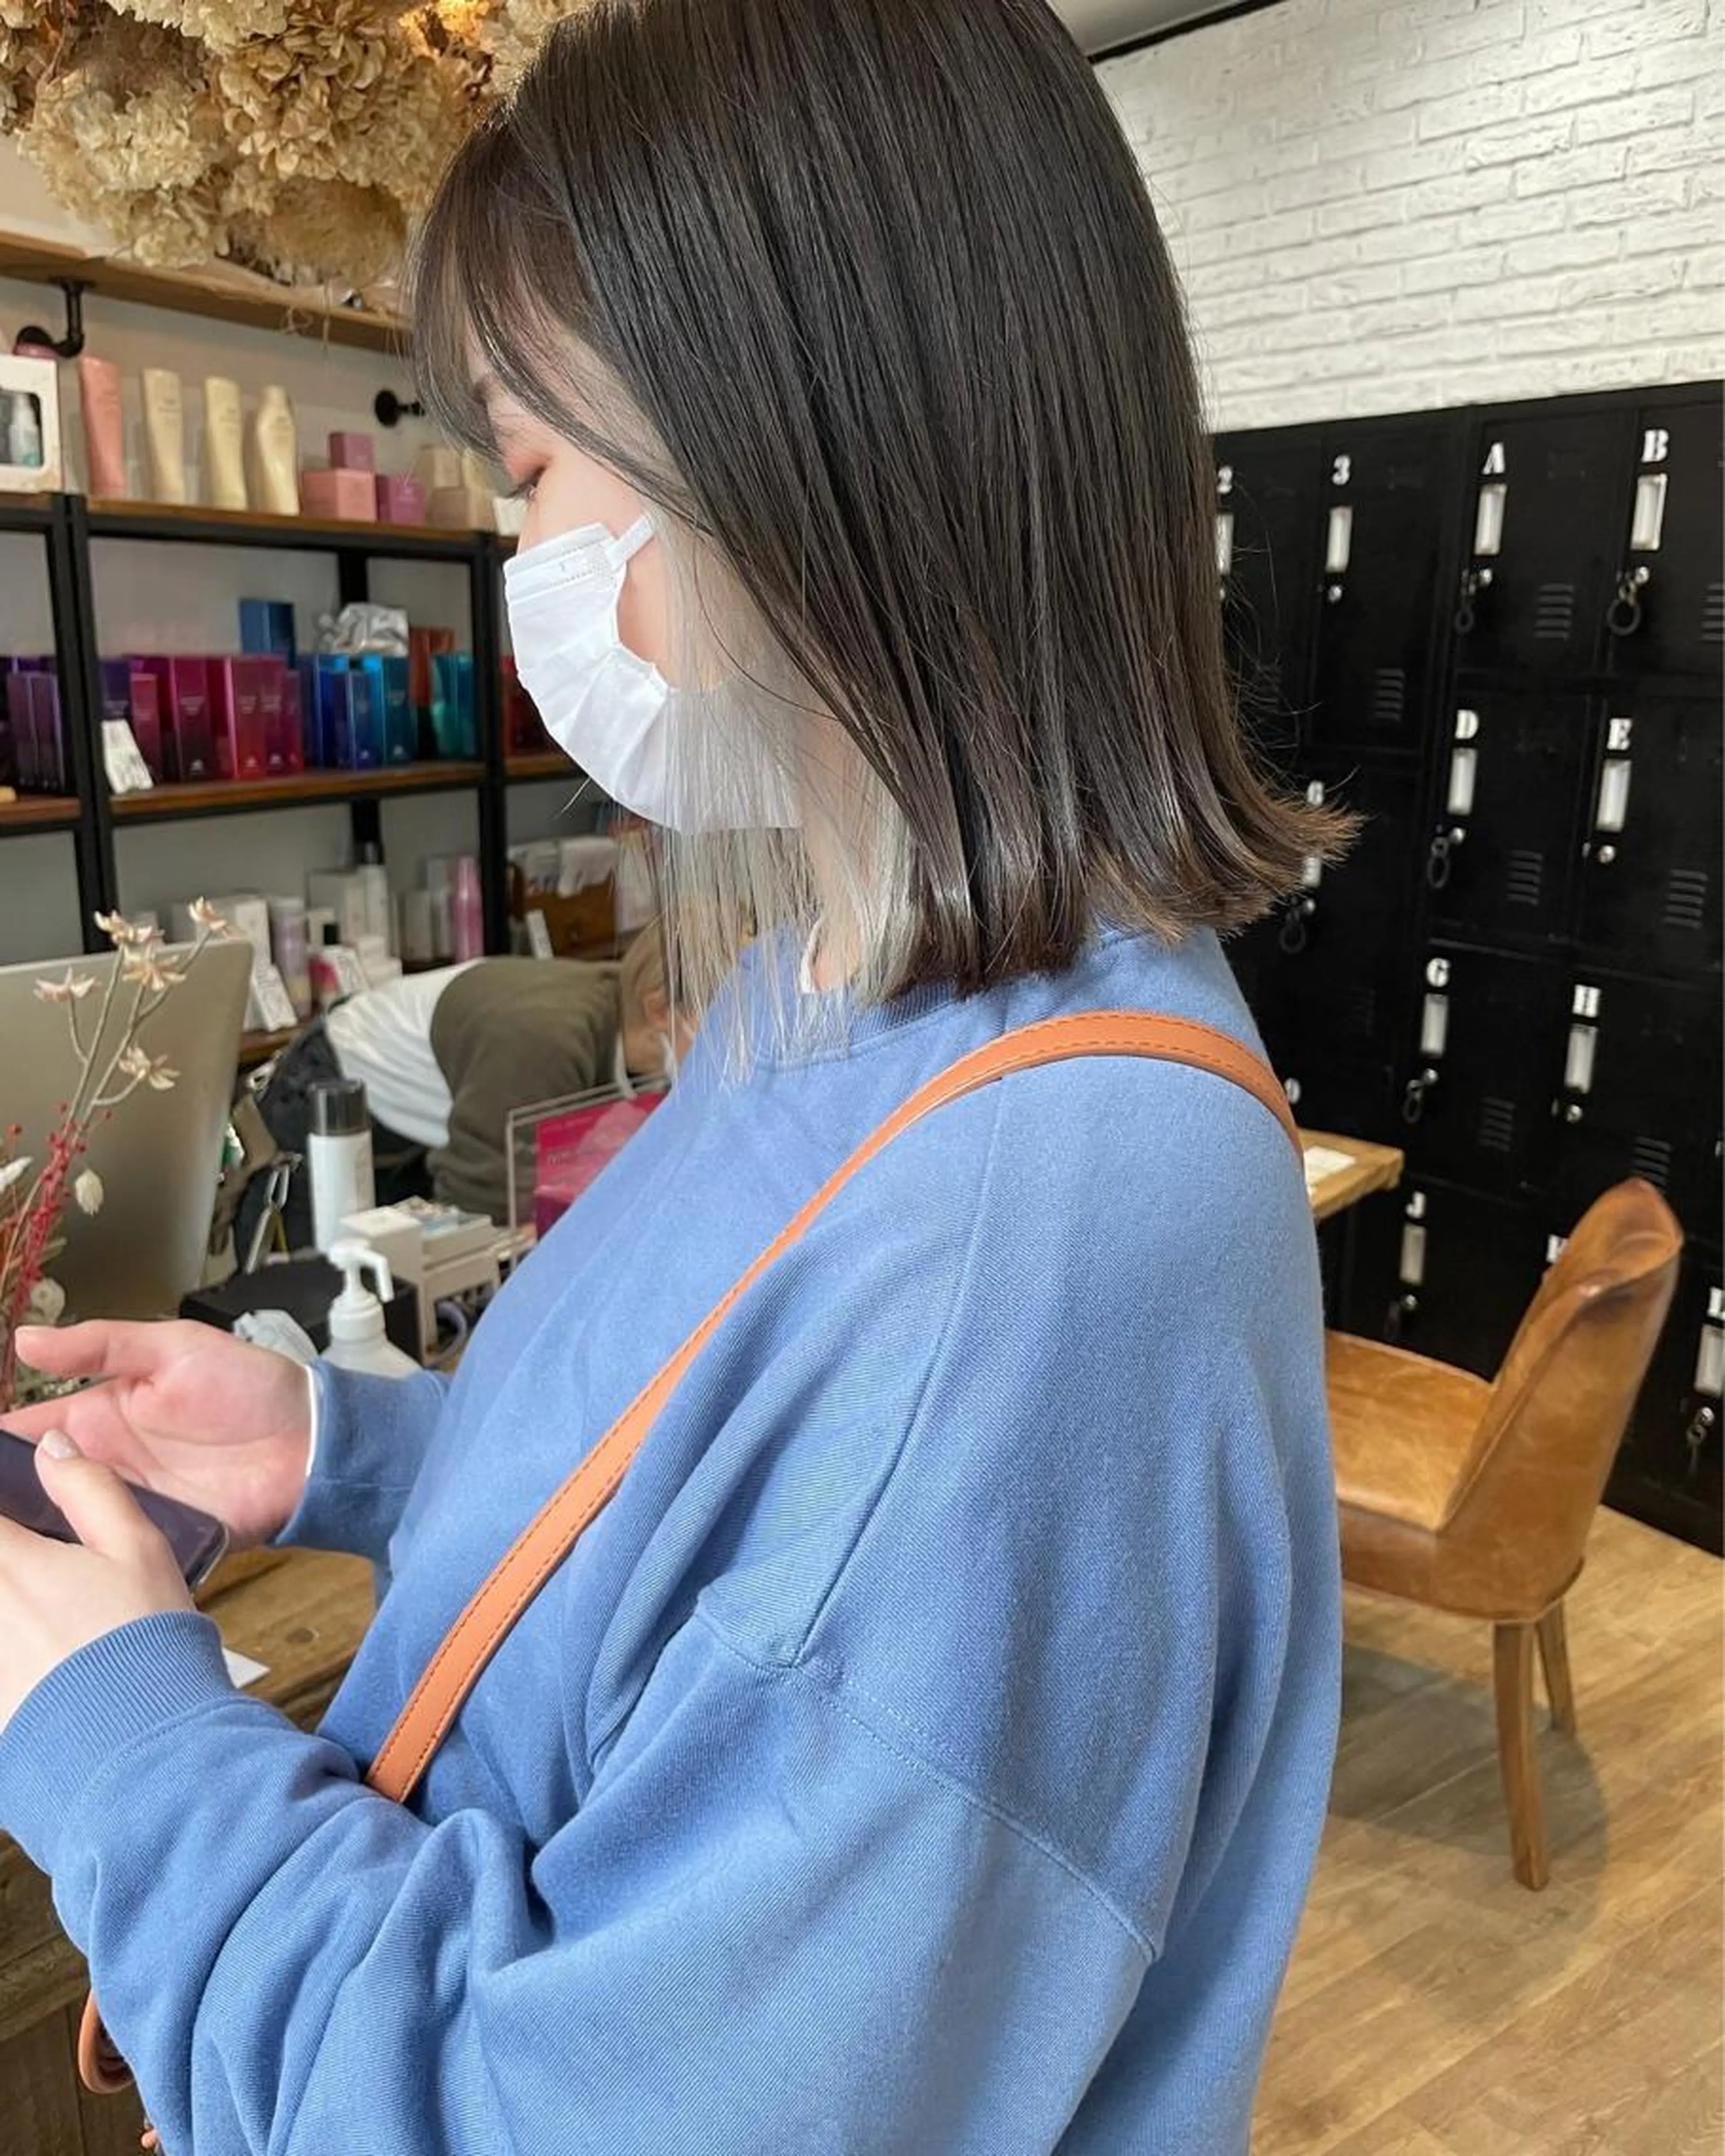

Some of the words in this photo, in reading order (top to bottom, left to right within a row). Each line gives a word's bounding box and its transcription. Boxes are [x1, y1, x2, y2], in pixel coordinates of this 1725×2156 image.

[1482, 442, 1505, 474] A
[1641, 429, 1669, 463] B
[1217, 466, 1233, 494] 2
[1332, 455, 1351, 485] 3
[1455, 709, 1479, 739] D
[1607, 718, 1632, 751] E
[1426, 958, 1451, 987] G
[1572, 984, 1601, 1018] H
[1406, 1191, 1425, 1218] J
